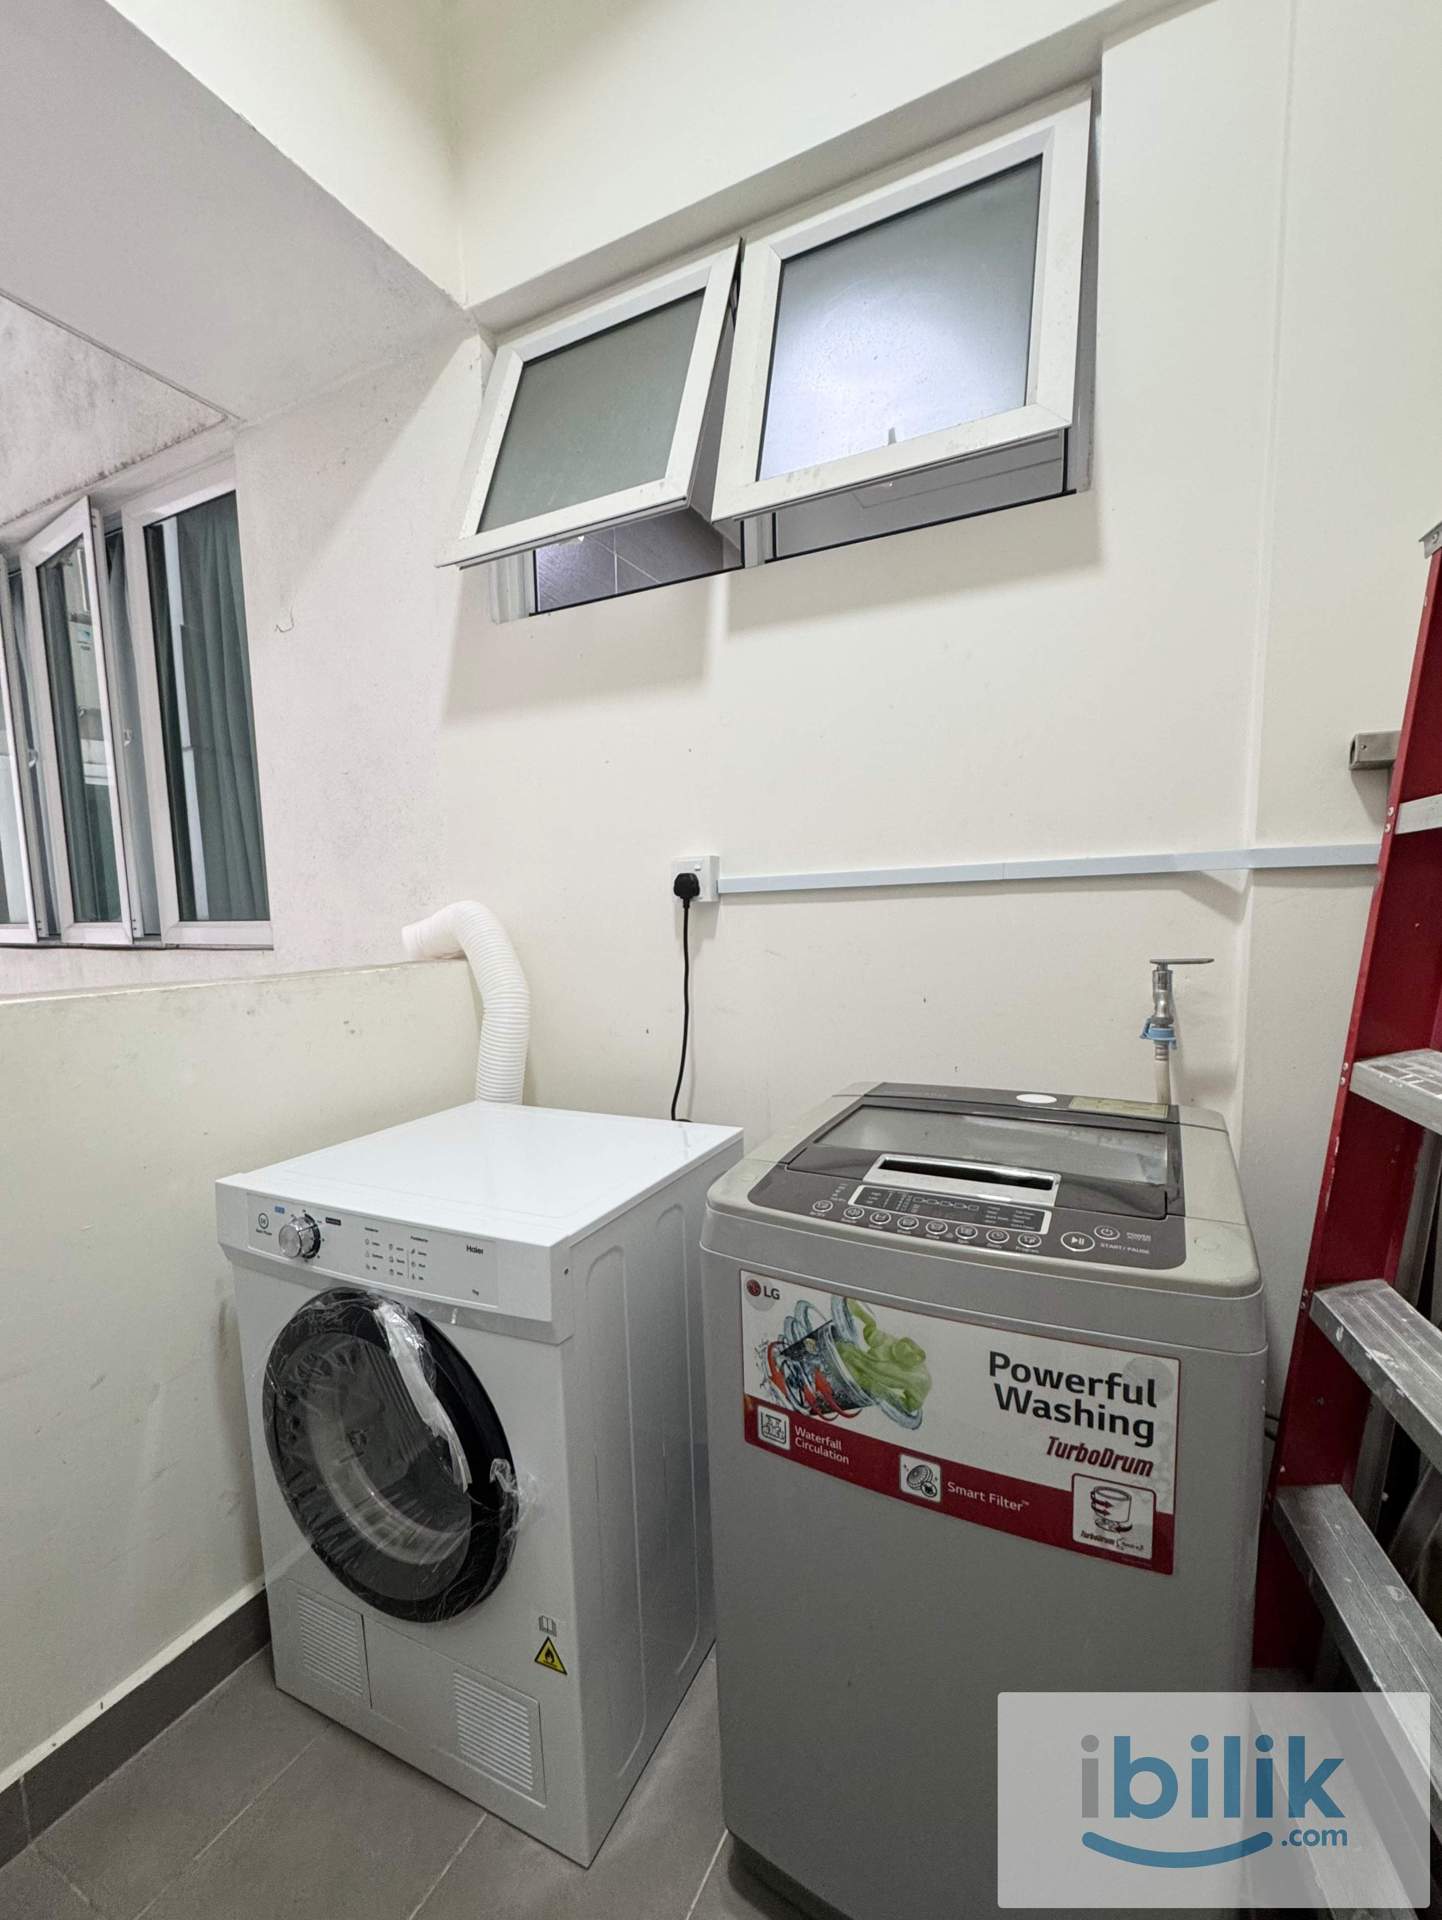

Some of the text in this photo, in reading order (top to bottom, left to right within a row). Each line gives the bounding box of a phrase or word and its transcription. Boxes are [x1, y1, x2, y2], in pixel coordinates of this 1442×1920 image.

[763, 1284, 780, 1301] LG
[989, 1351, 1157, 1408] Powerful
[994, 1382, 1154, 1448] Washing
[794, 1424, 842, 1451] Waterfall
[795, 1437, 849, 1465] Circulation
[1046, 1435, 1154, 1478] TurboDrum
[947, 1481, 987, 1503] Smart
